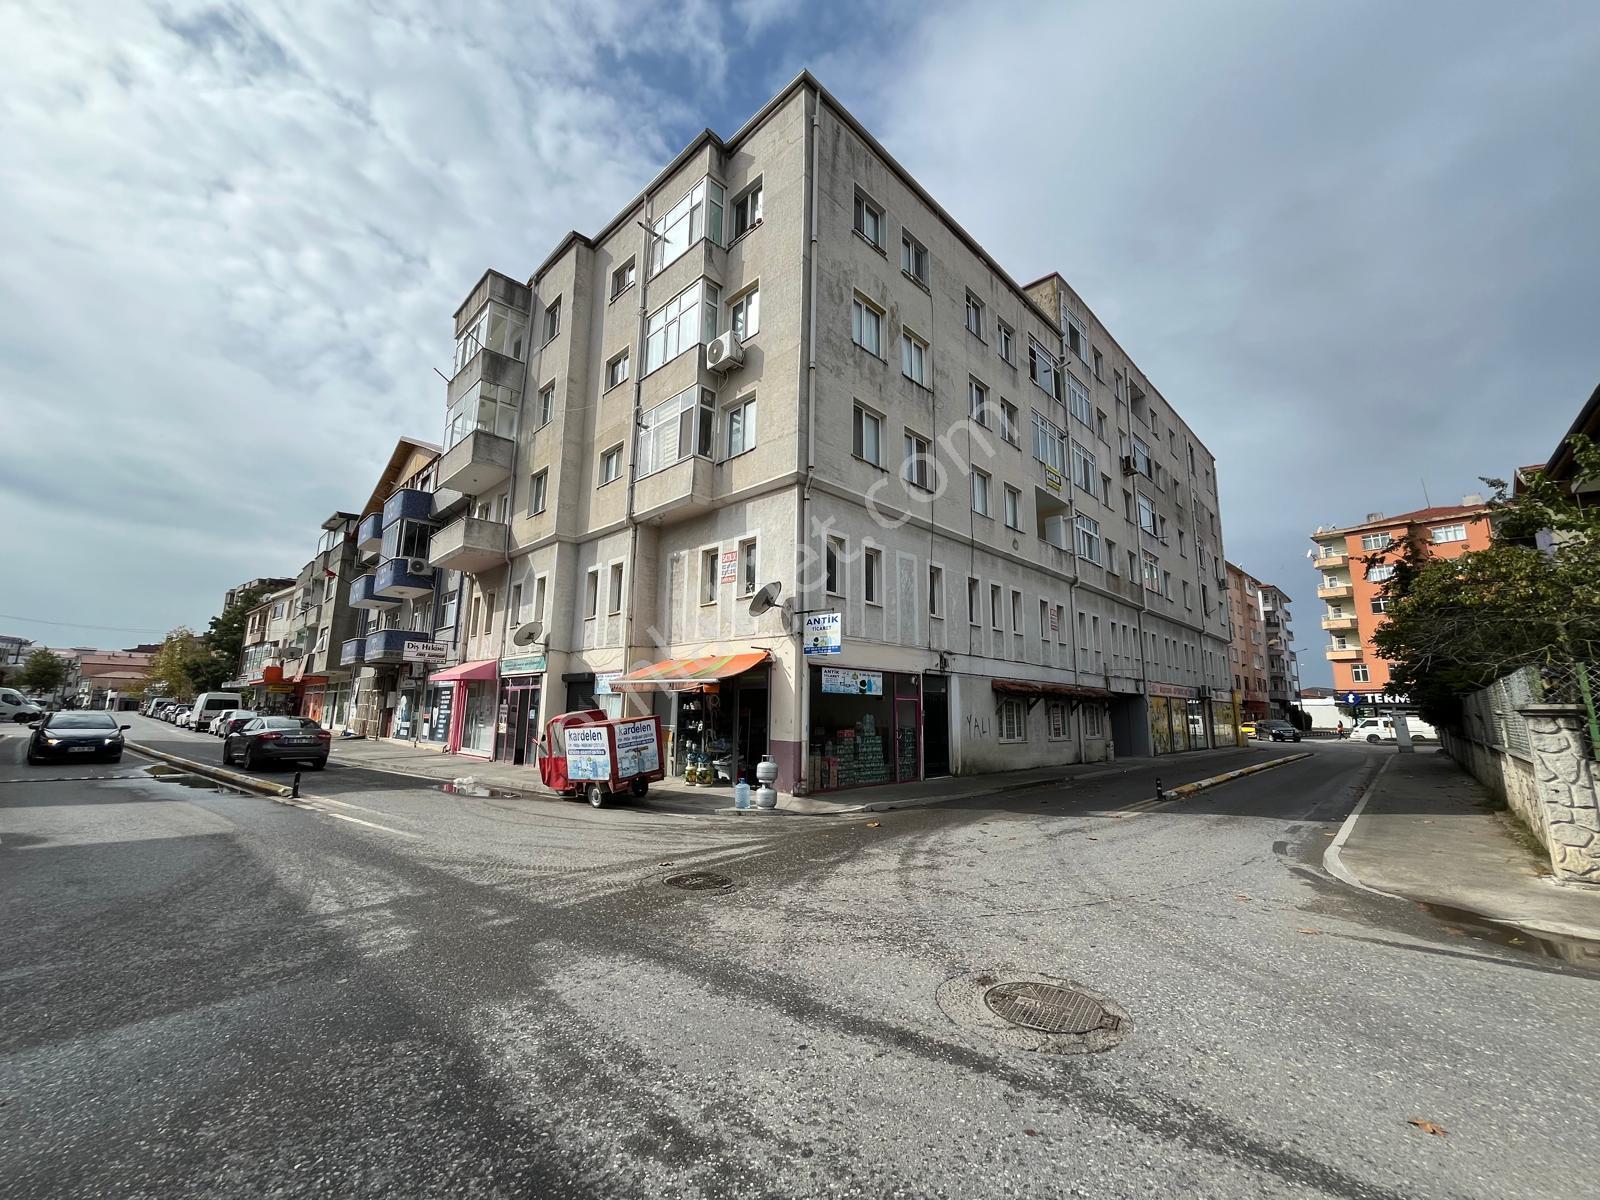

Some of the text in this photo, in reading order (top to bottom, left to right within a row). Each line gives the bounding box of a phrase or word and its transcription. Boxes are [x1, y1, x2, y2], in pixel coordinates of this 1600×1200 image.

[806, 614, 839, 626] ANTİK
[618, 723, 652, 736] kardelen
[966, 714, 991, 739] YALI
[568, 729, 603, 742] kardelen
